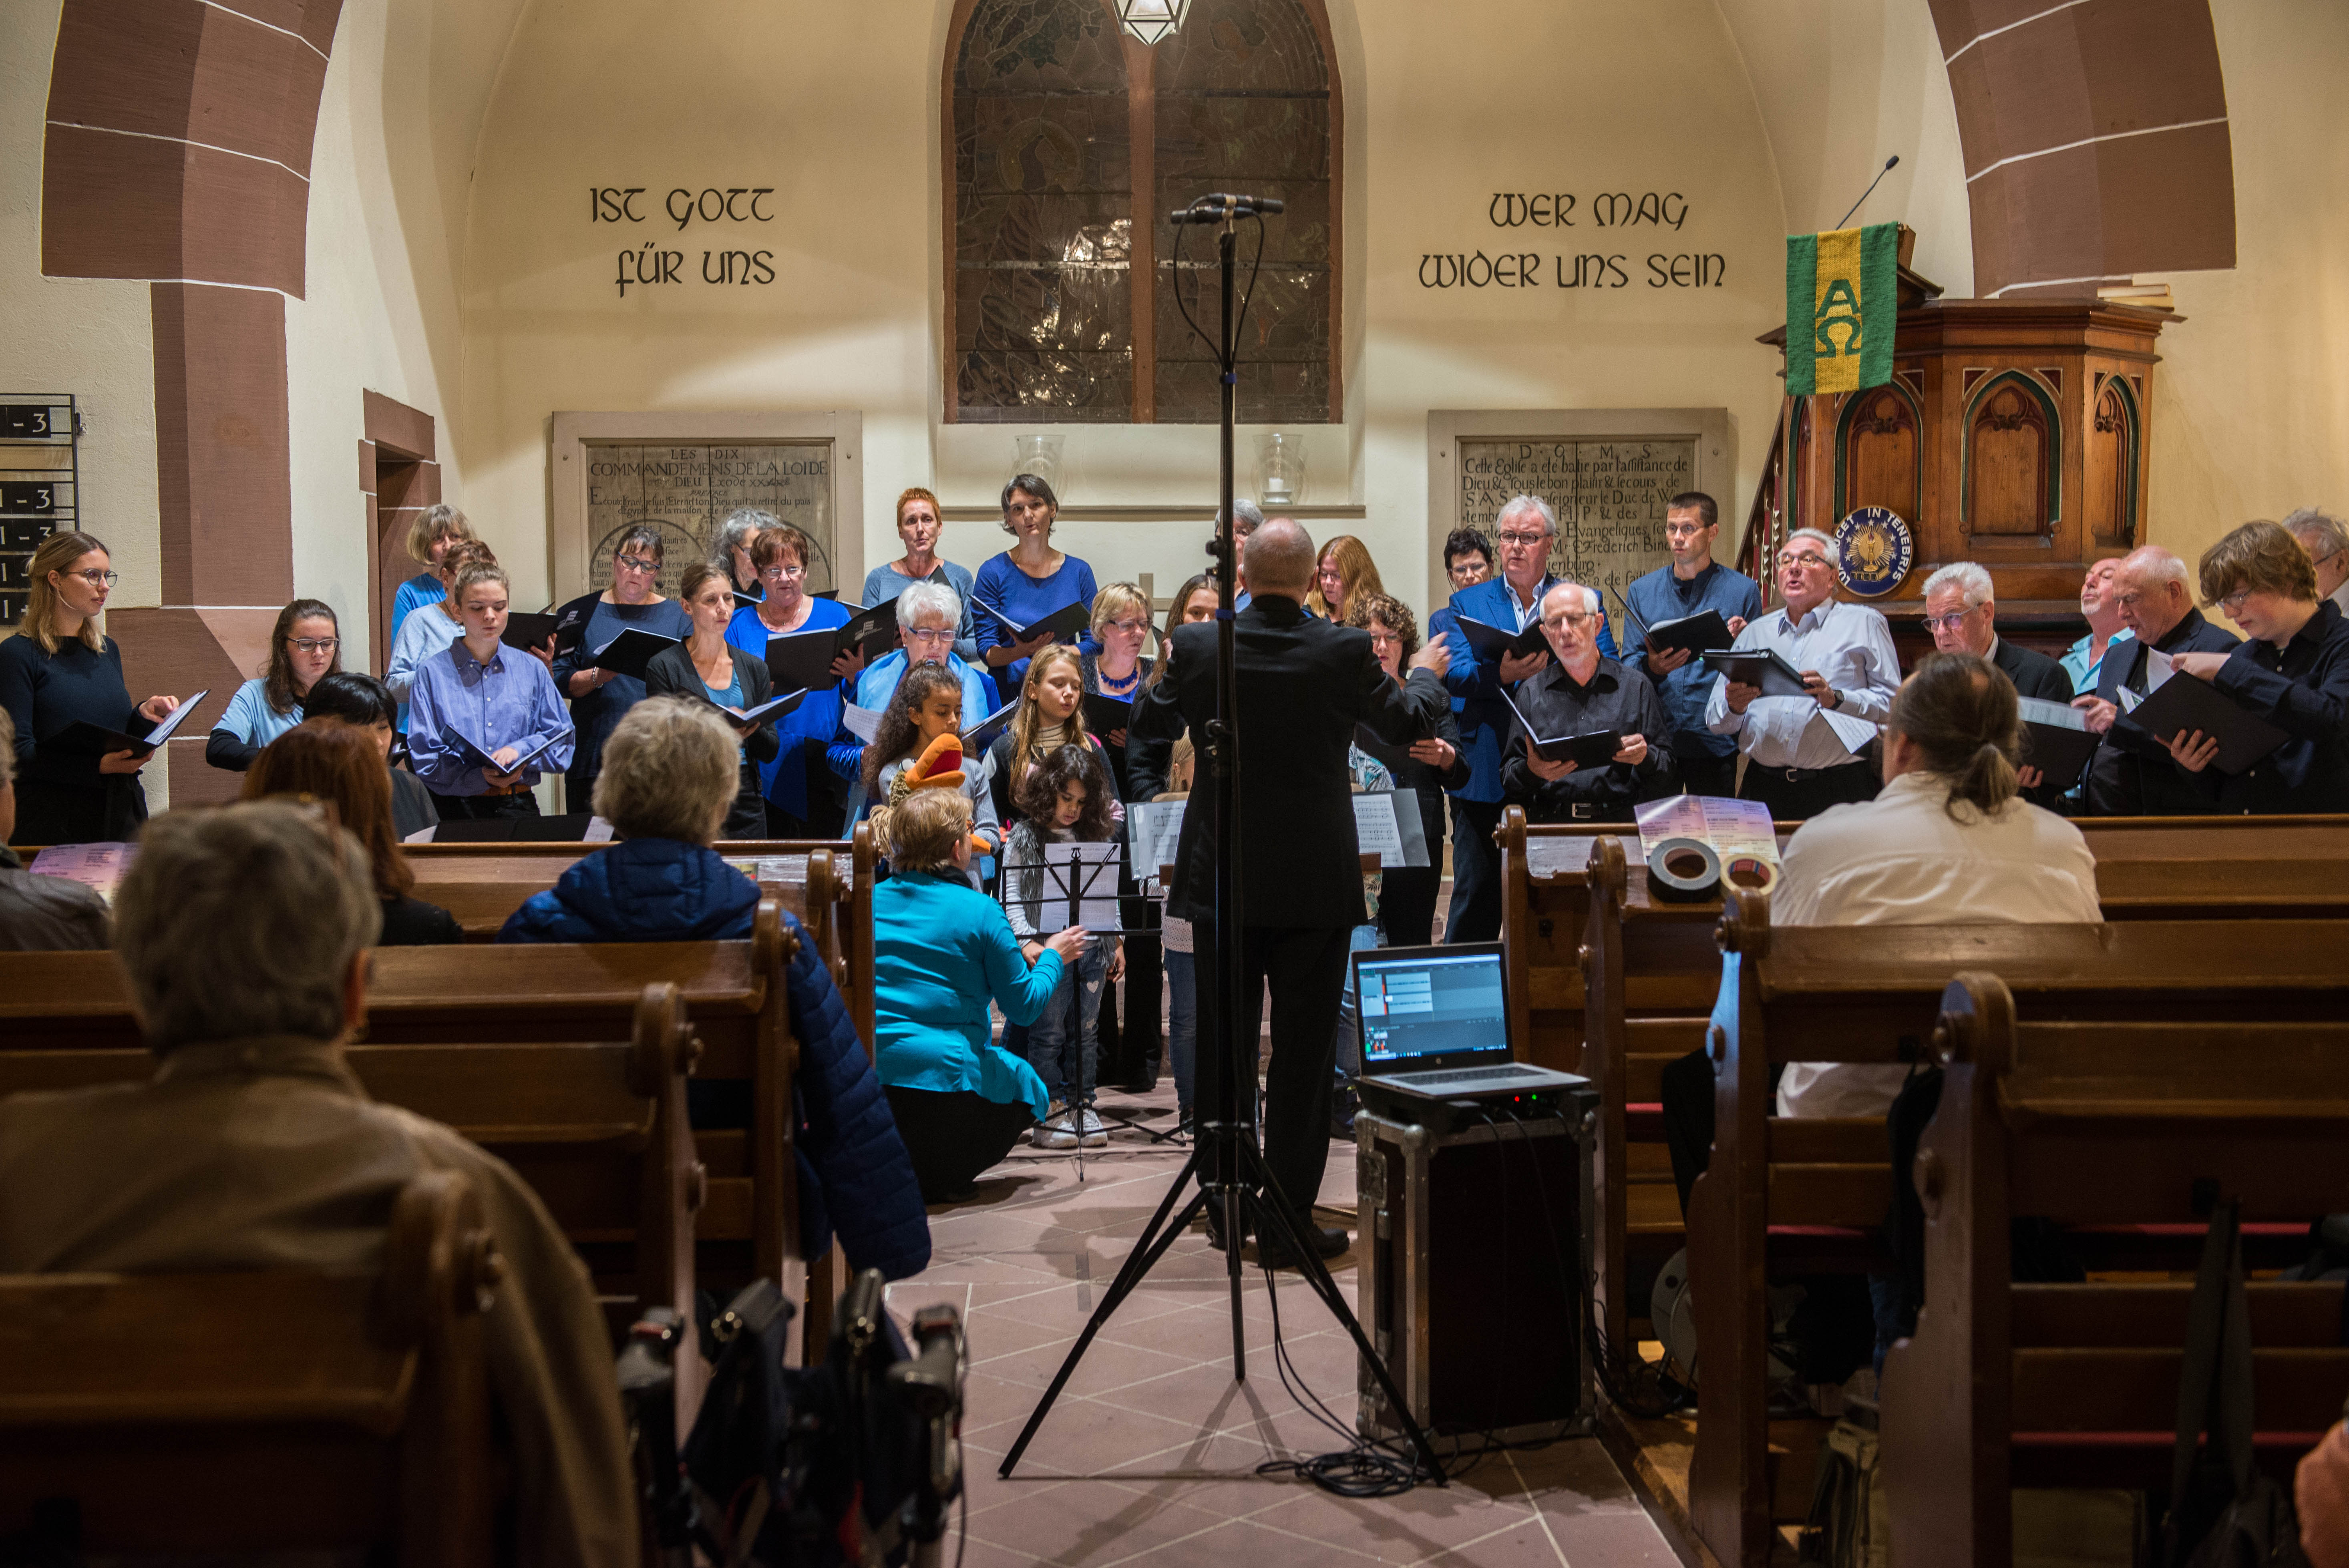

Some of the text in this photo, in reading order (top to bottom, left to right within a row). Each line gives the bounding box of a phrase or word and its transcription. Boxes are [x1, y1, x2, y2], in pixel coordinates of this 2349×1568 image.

[590, 188, 774, 231] IST GOTT
[1489, 193, 1689, 231] WER MAG
[702, 250, 775, 284] UNS
[1419, 249, 1725, 288] WIDER UNS SEIN
[32, 413, 47, 433] 3
[671, 449, 739, 460] LES DIX
[591, 462, 731, 476] COMMANDEMENS
[1593, 460, 1613, 477] par
[1674, 455, 1687, 472] de
[675, 477, 702, 487] DIEU
[1666, 473, 1679, 488] de
[36, 489, 50, 509] 3
[710, 497, 730, 506] Dieu
[780, 495, 792, 506] du
[1612, 490, 1637, 505] Duc
[1642, 489, 1655, 503] de
[1617, 505, 1637, 519] des
[1867, 507, 1881, 518] IN
[1886, 512, 1911, 581] TENEBRIS
